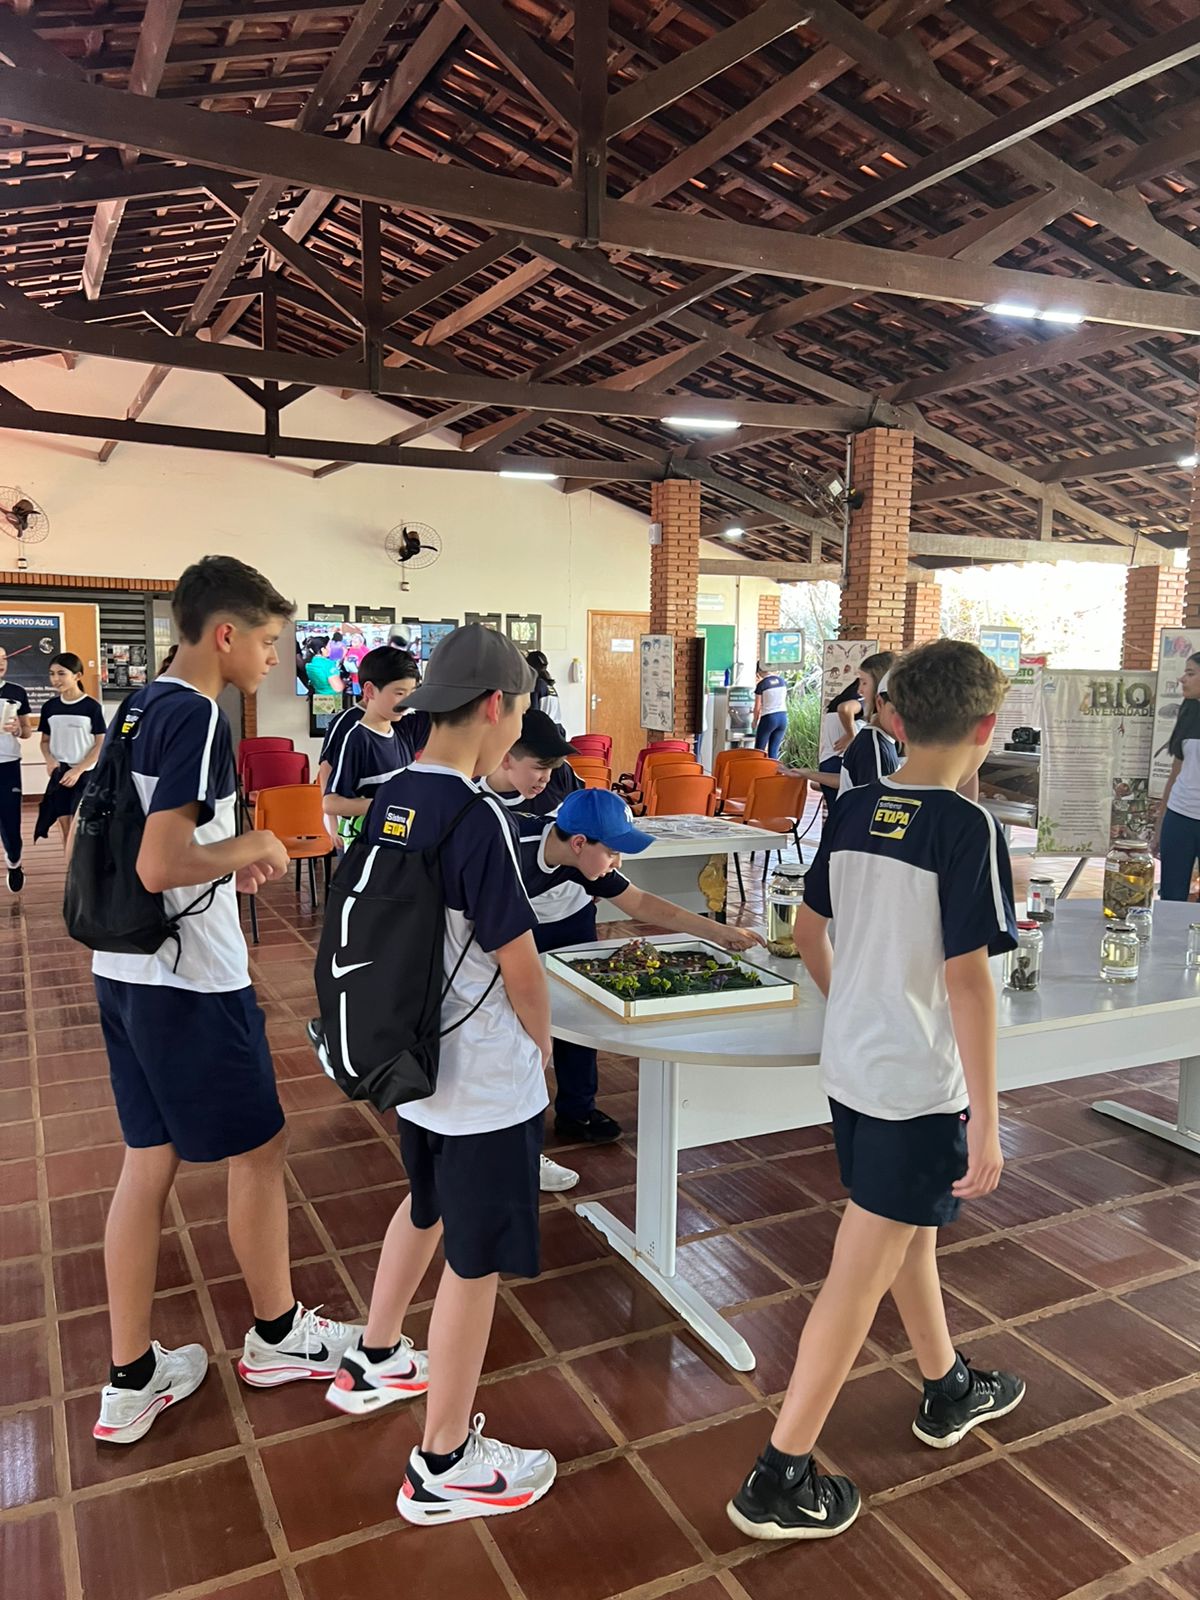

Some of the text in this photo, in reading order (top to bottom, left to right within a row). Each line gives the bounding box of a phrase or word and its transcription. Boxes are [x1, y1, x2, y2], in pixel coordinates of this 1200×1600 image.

[9, 618, 35, 626] PONTO
[1083, 708, 1155, 717] DIVERSIDADE
[875, 809, 910, 825] ETAPA
